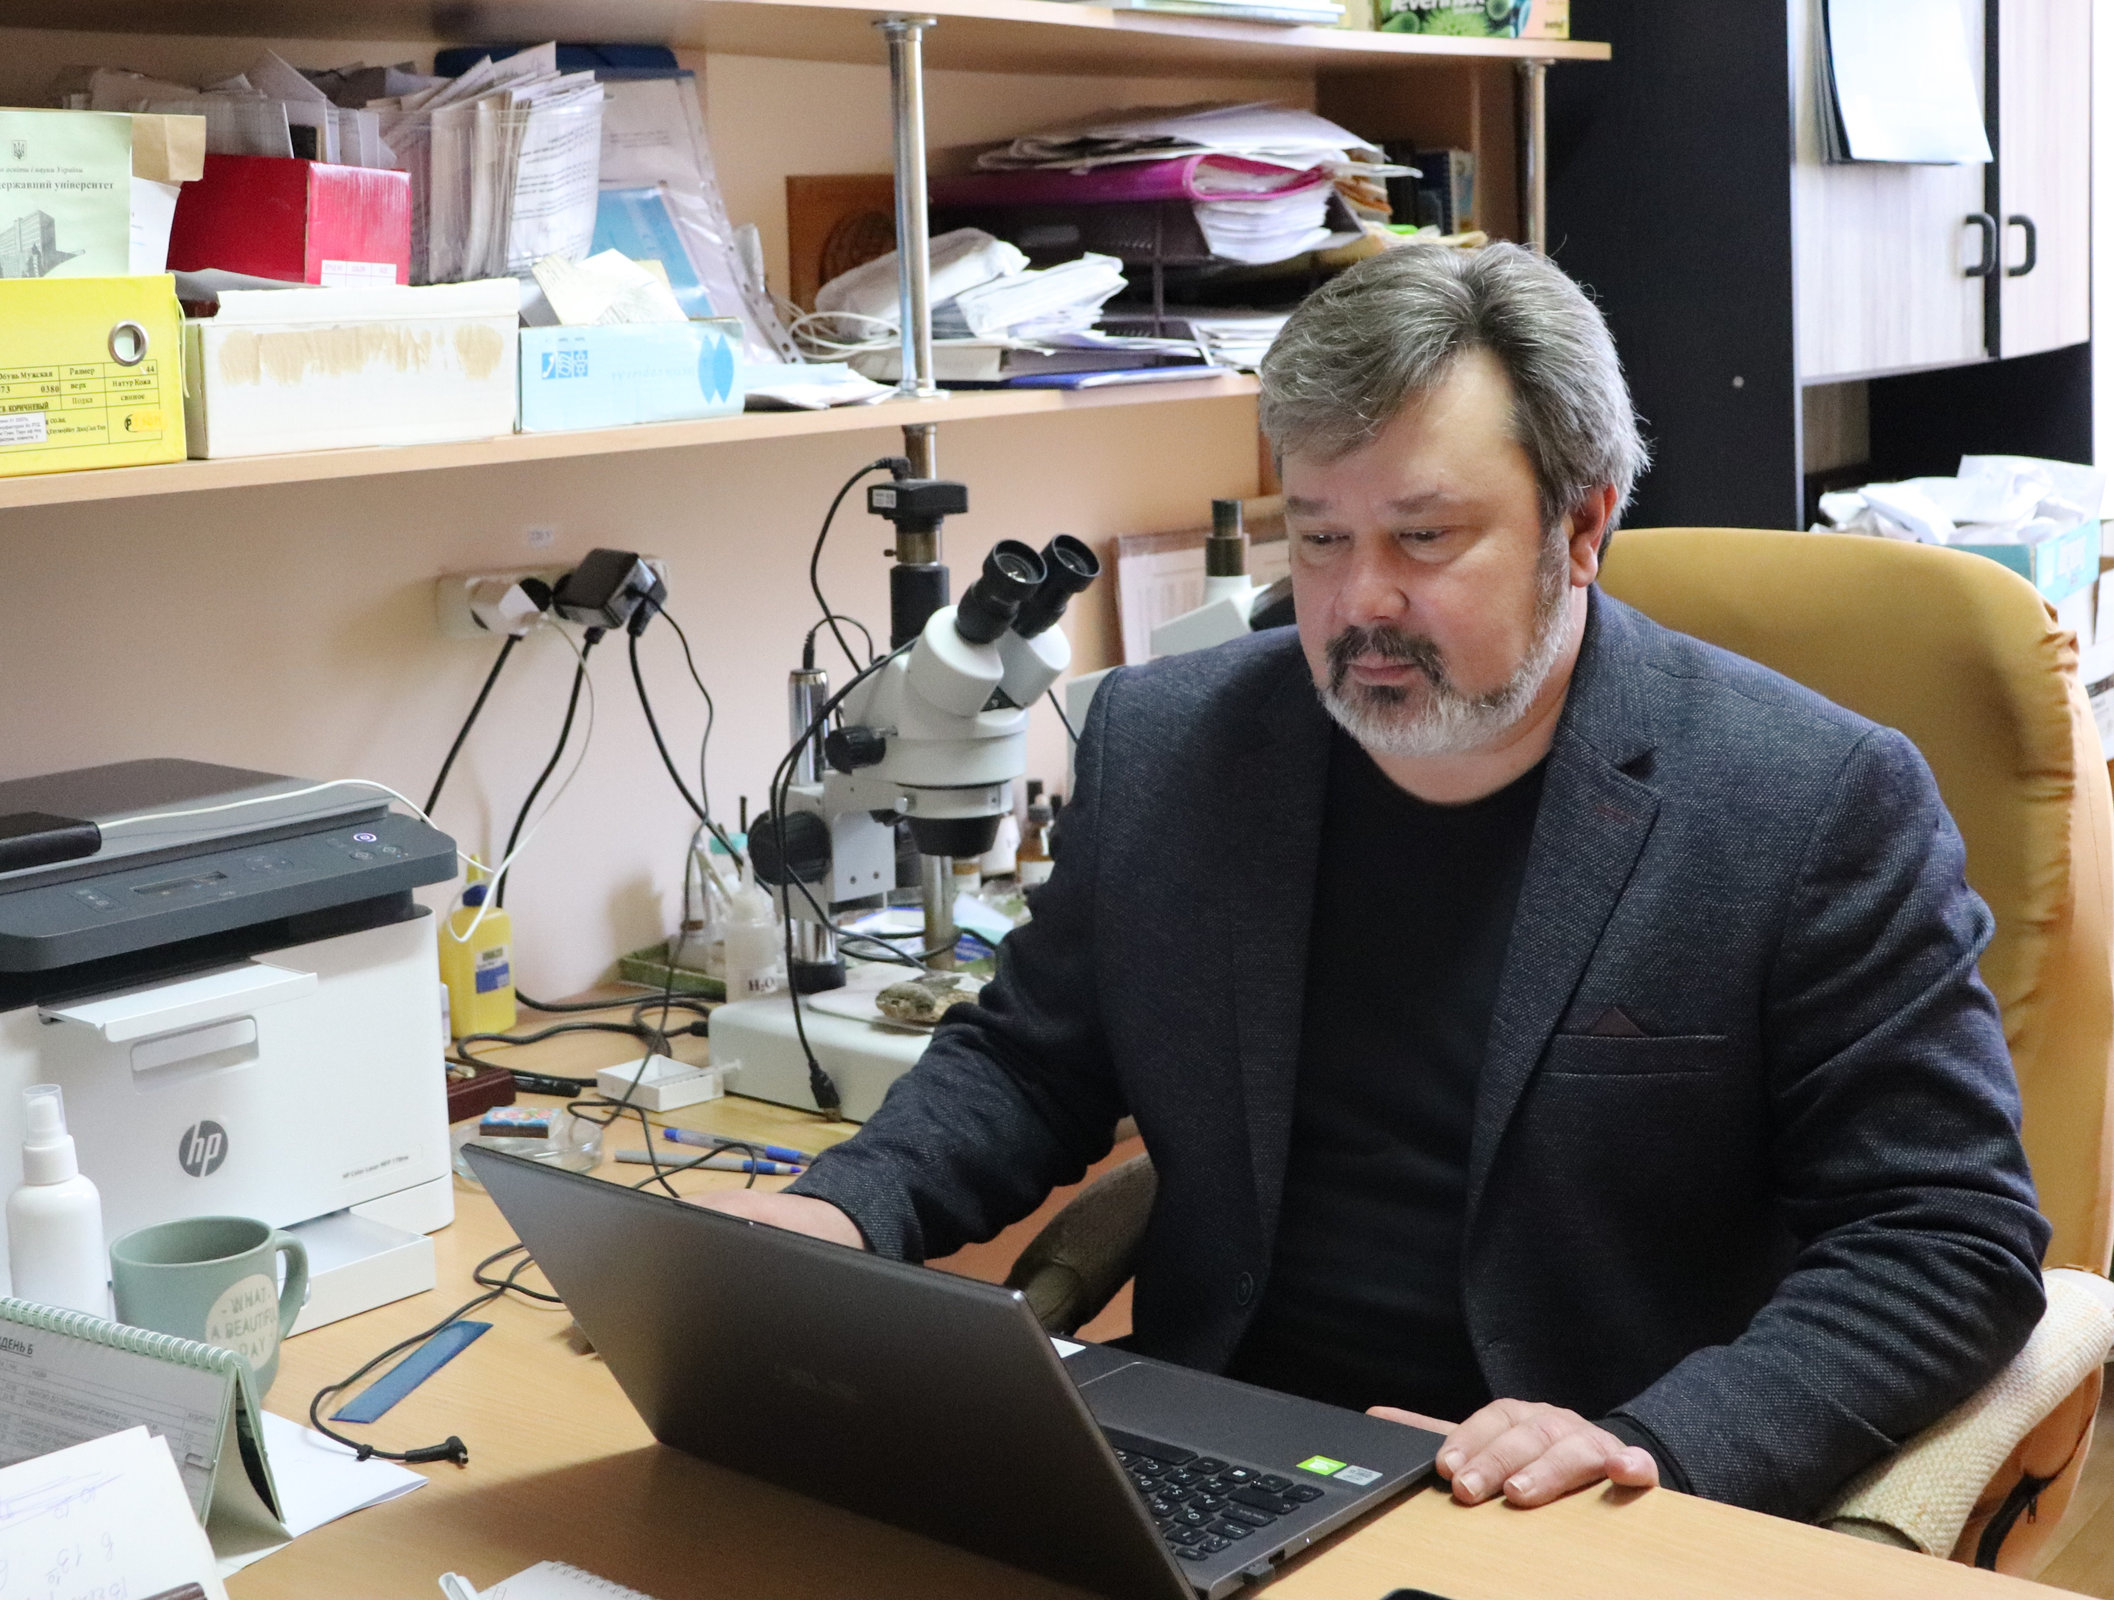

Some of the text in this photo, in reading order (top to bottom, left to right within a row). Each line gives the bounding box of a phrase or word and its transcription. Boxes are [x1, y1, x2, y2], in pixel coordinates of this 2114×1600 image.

[55, 180, 114, 191] університет
[20, 370, 53, 379] Мужская
[40, 385, 60, 393] 0380
[187, 1121, 222, 1177] hp
[231, 1287, 266, 1314] WHAT
[0, 1336, 26, 1353] ДЕНЬ
